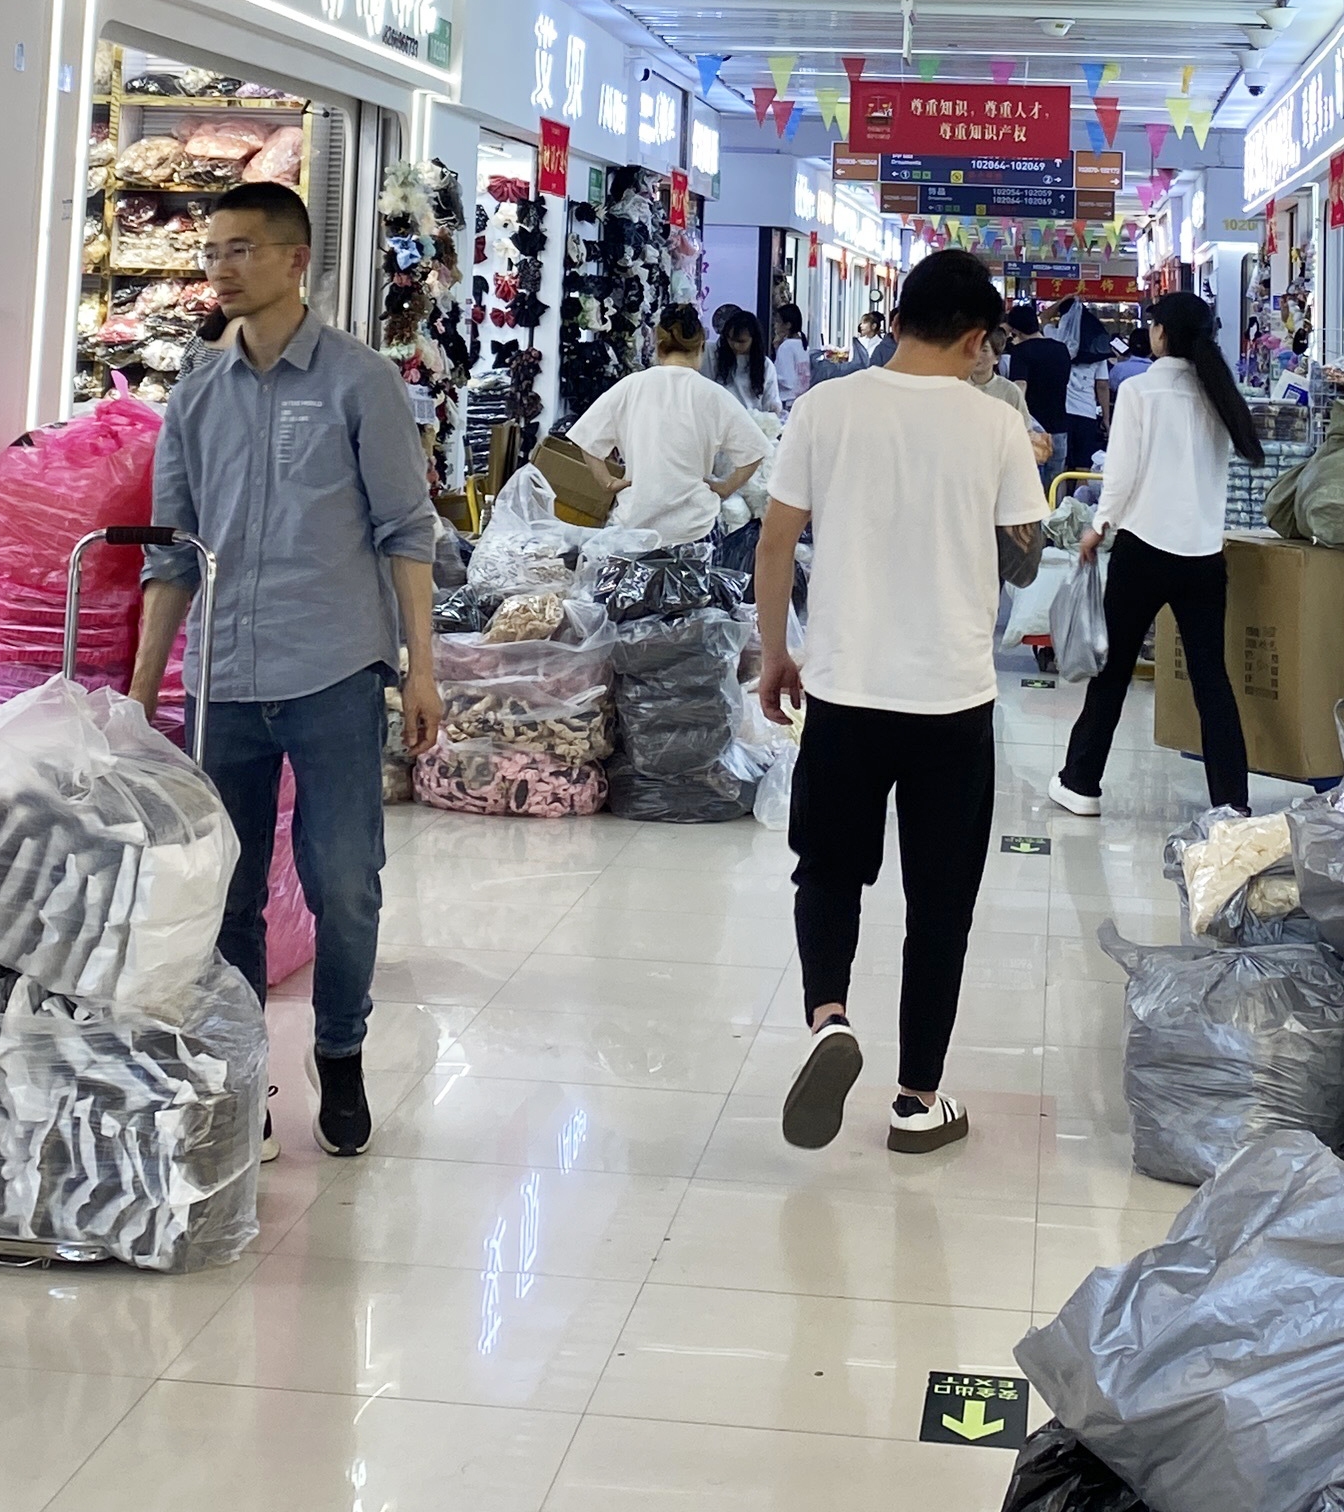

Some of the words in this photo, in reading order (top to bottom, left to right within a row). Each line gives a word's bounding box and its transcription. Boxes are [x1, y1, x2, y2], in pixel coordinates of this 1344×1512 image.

[938, 122, 1028, 143] 尊重知识产权
[971, 160, 1046, 172] 102064-102069
[933, 1384, 1019, 1400] 安全出口
